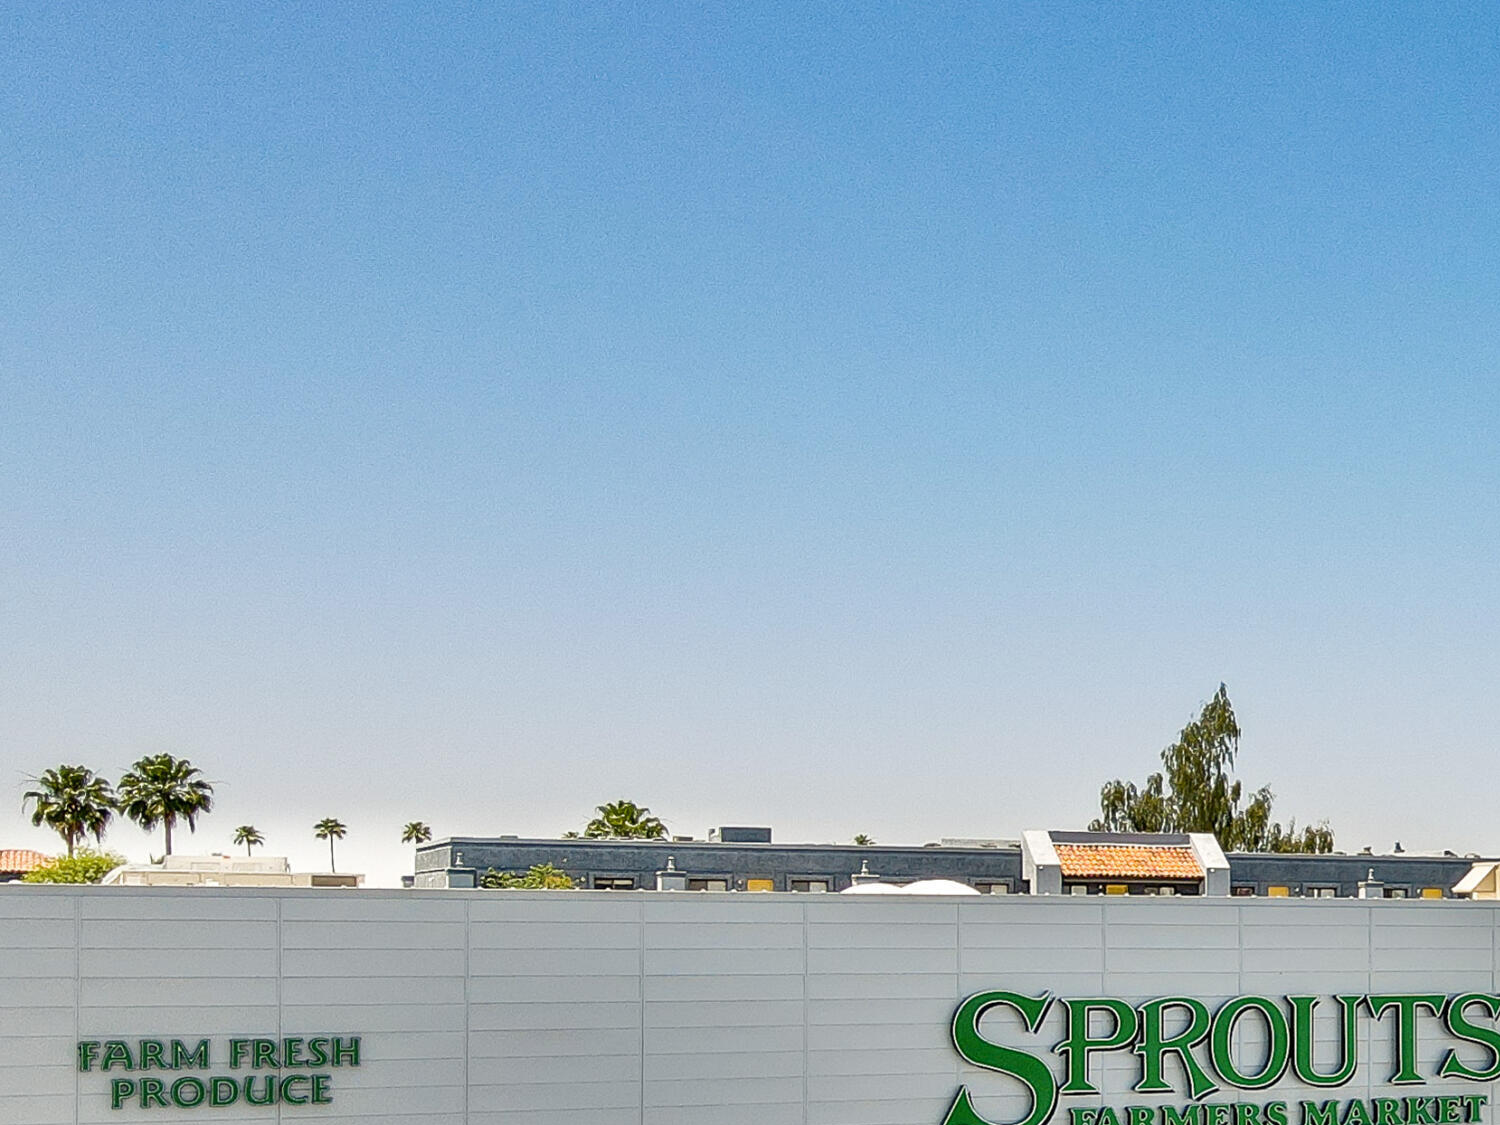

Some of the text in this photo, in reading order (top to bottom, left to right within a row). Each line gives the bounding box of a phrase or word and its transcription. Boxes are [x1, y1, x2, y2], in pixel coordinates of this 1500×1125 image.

[77, 1036, 362, 1072] FARM FRESH
[111, 1074, 334, 1110] PRODUCE
